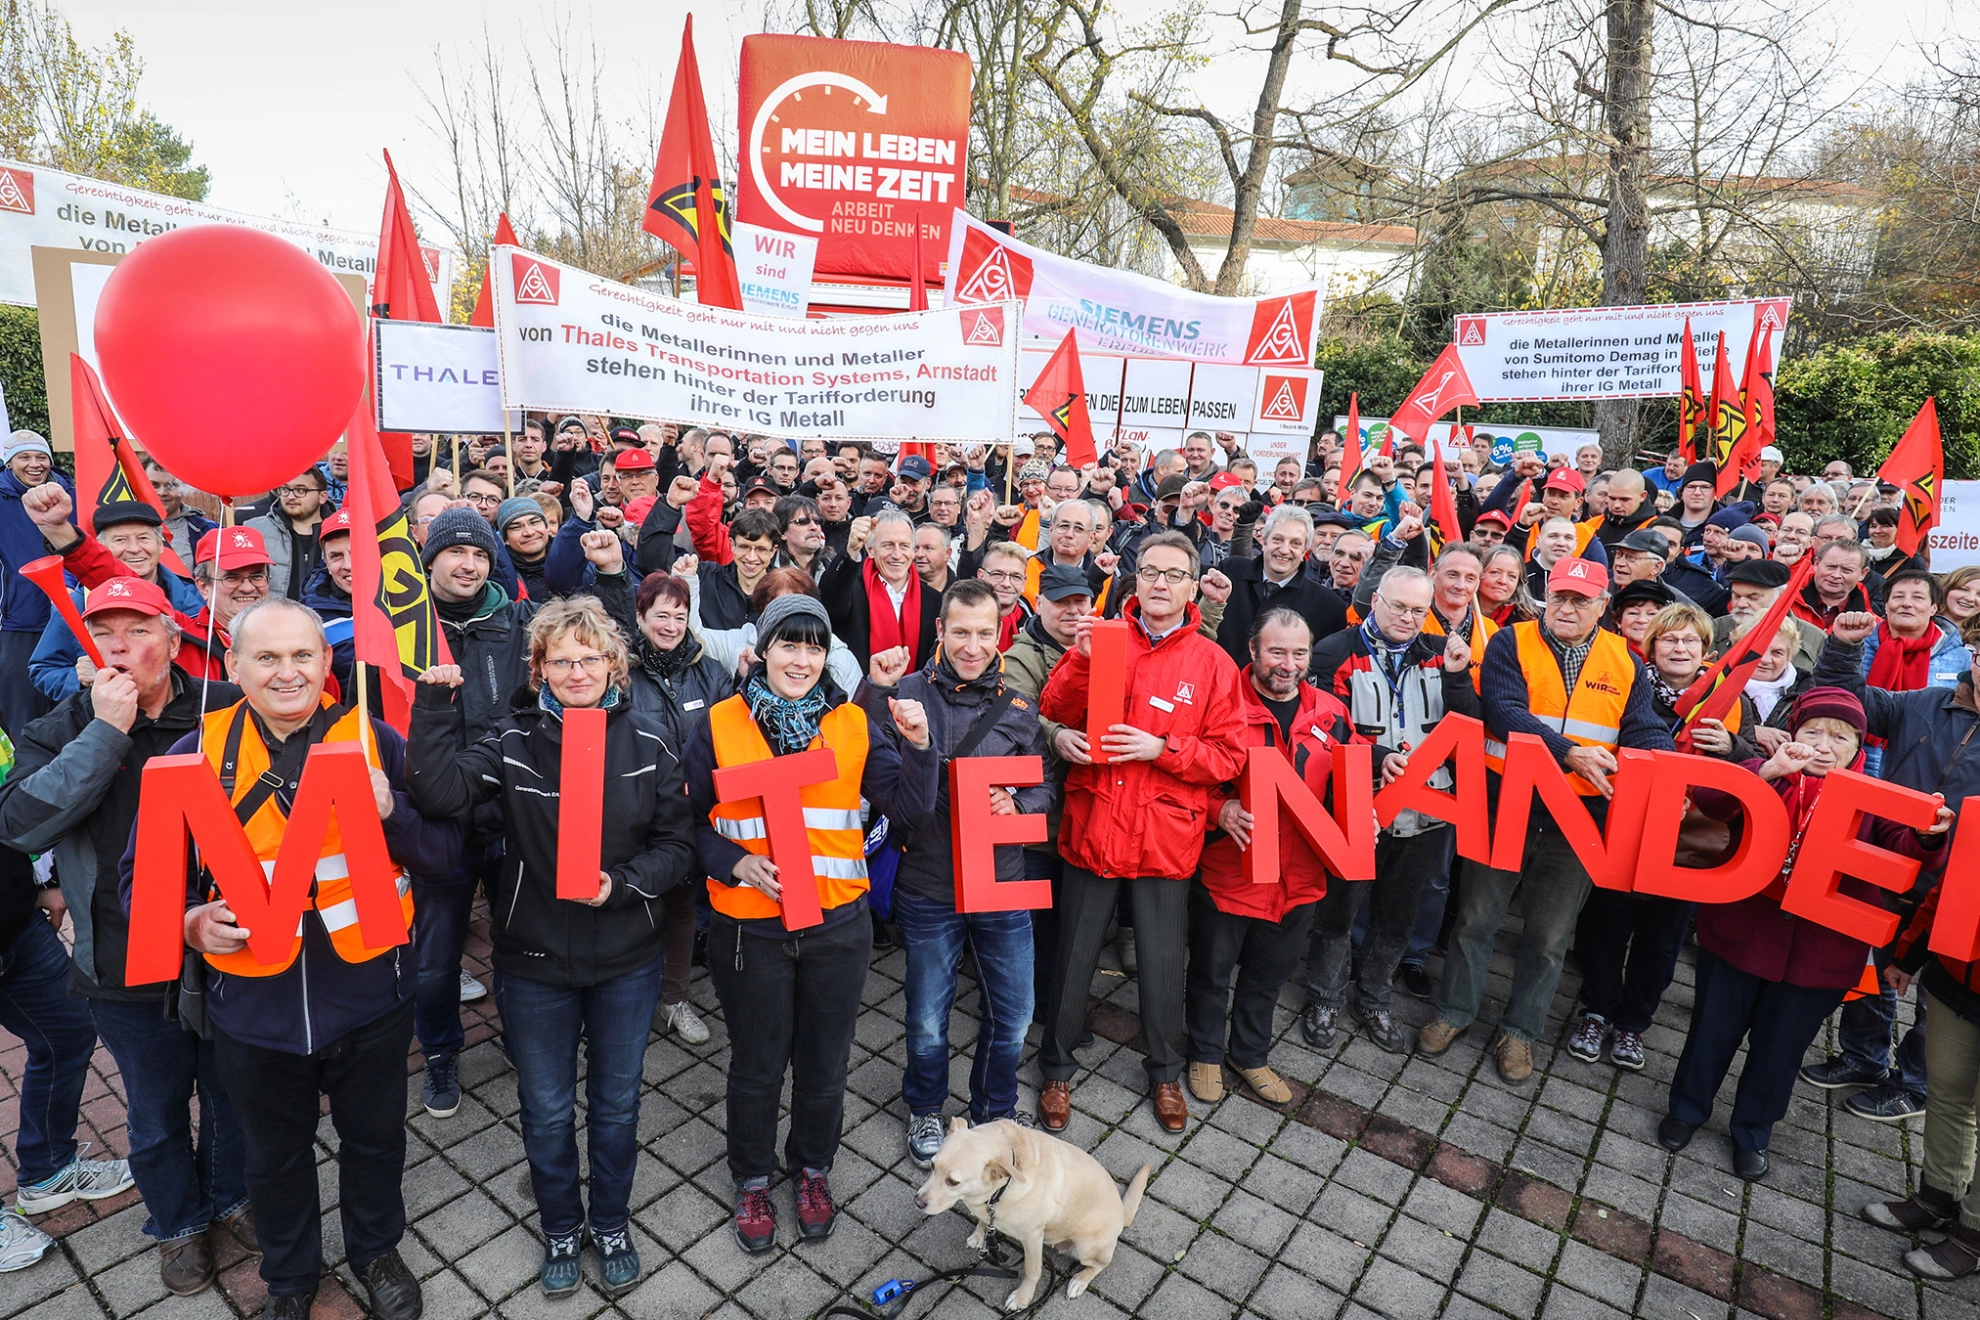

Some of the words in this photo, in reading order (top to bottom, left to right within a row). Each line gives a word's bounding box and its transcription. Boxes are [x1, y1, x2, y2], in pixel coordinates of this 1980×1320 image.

[781, 127, 856, 158] MEIN
[862, 133, 956, 166] LEBEN
[780, 162, 873, 192] MEINE
[876, 168, 955, 203] ZEIT
[57, 203, 96, 226] die
[65, 183, 161, 210] Gerechtigkeit
[165, 204, 194, 216] geht
[197, 209, 222, 222] nur
[281, 226, 314, 239] nicht
[316, 231, 351, 244] gegen
[354, 235, 377, 249] uns
[831, 200, 895, 219] ARBEIT
[831, 218, 866, 236] NEU
[871, 221, 941, 241] DENKEN
[755, 233, 796, 259] WIR
[756, 263, 787, 280] sind
[741, 282, 800, 305] IEMENS
[742, 296, 780, 308] eratorenwerk
[588, 283, 684, 318] Gerechtigkeit
[686, 311, 718, 325] geht
[720, 317, 747, 330] nur
[750, 320, 775, 333] mit
[779, 324, 807, 336] und
[810, 325, 846, 336] nicht
[849, 324, 890, 338] gegen
[893, 321, 920, 331] uns
[1079, 298, 1202, 341] SIEMENS
[1503, 317, 1560, 327] Gerechtigkeit
[1563, 315, 1583, 326] geht
[1605, 312, 1622, 321] mit
[1624, 311, 1644, 320] und
[1647, 310, 1672, 319] nicht
[1674, 310, 1703, 321] gegen
[601, 313, 634, 333] die
[641, 324, 787, 367] Metallerinnen
[794, 353, 835, 366] und
[842, 349, 926, 366] Metaller
[1047, 304, 1229, 358] GENERATORENWERK
[1509, 339, 1530, 350] die
[1534, 336, 1629, 350] Metallerinnen
[1634, 333, 1662, 346] und
[518, 327, 553, 342] von
[561, 324, 639, 352] Thales
[646, 342, 805, 387] Transportation
[812, 369, 910, 389] Systems,
[916, 363, 998, 382] Arnstadt
[1504, 355, 1529, 365] von
[1533, 352, 1605, 365] Sumitomo
[1609, 351, 1660, 363] Demag
[1664, 348, 1678, 359] in
[389, 364, 499, 386] THALE
[586, 356, 666, 381] stehen
[674, 369, 736, 398] hinter
[743, 389, 778, 406] der
[784, 388, 937, 408] Tarifforderung
[1502, 366, 1547, 379] stehen
[1551, 367, 1592, 378] hinter
[1596, 366, 1620, 377] der
[1561, 381, 1594, 393] ihrer
[1598, 380, 1614, 391] IG
[1619, 378, 1662, 391] Metall
[690, 393, 742, 418] ihrer
[749, 408, 772, 426] IG
[780, 410, 845, 427] Metall
[1100, 394, 1119, 412] DIE
[1124, 396, 1149, 414] ZUM
[1150, 397, 1188, 416] LEBEN
[1192, 400, 1237, 420] PASSEN
[1492, 443, 1512, 457] 6%
[1928, 531, 1980, 550] szeite
[1585, 680, 1608, 692] WIR
